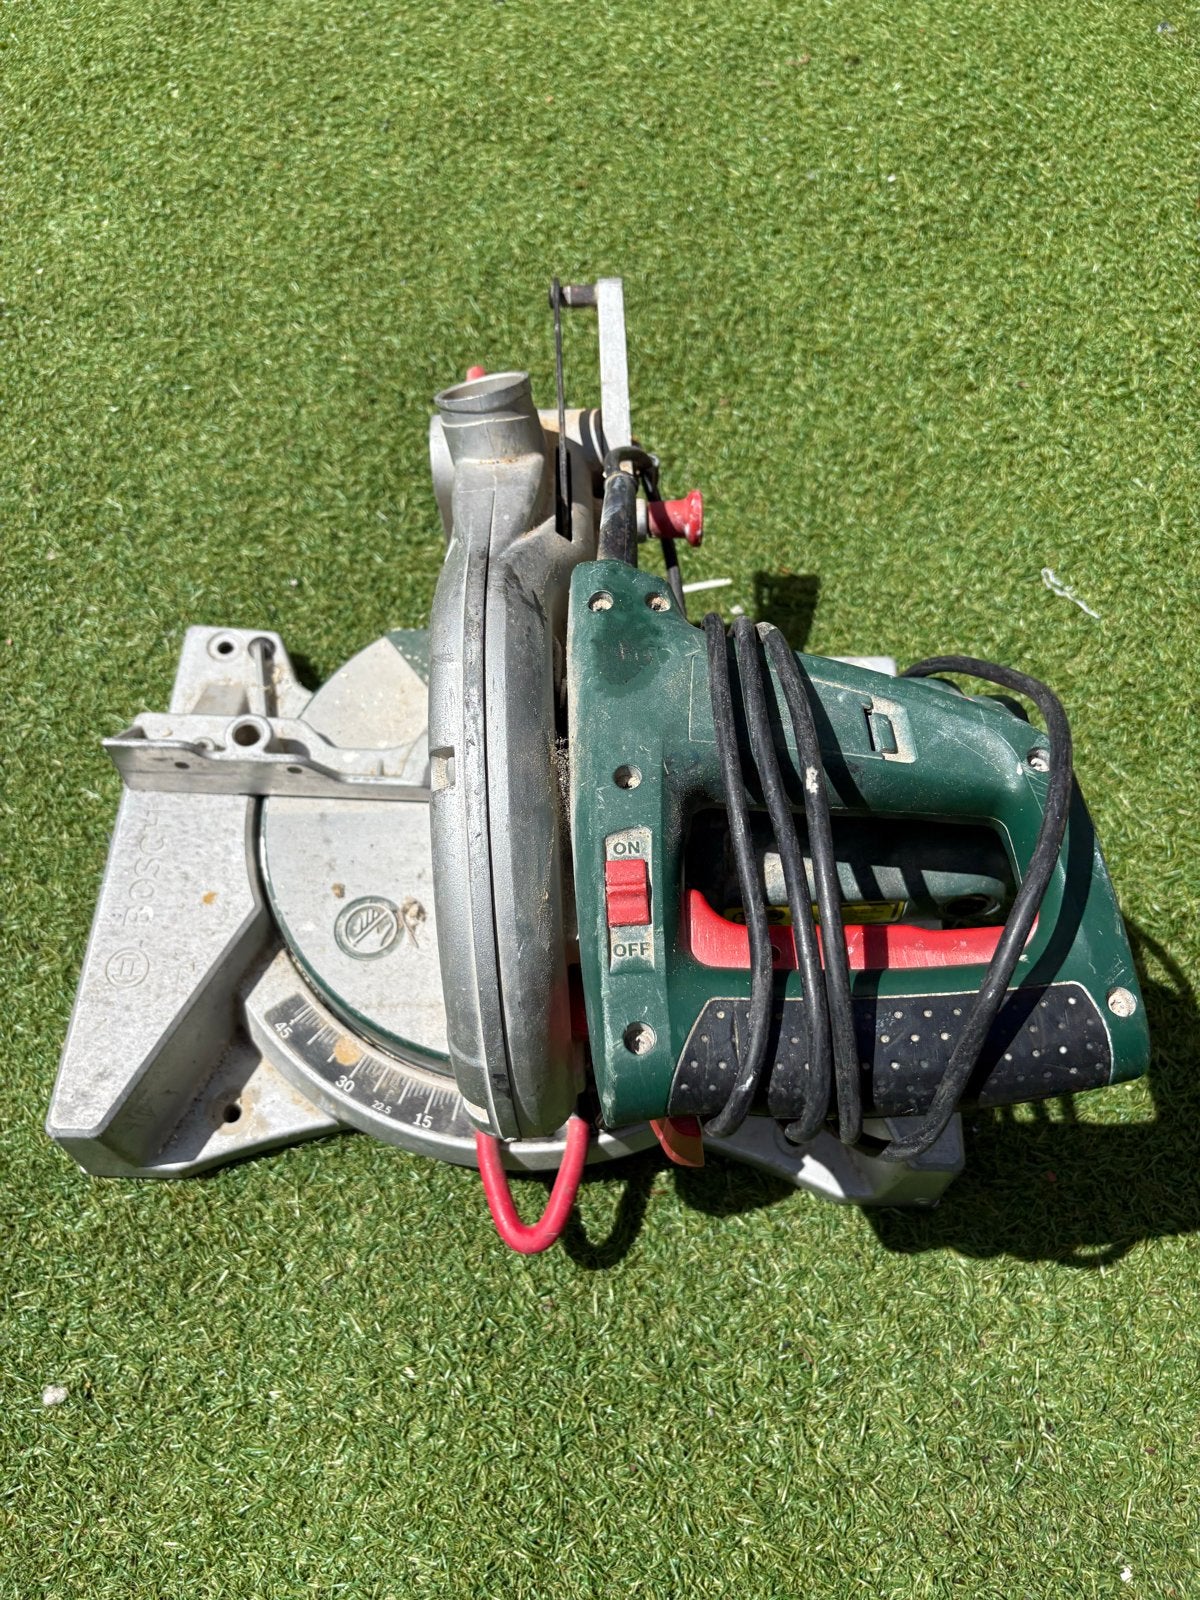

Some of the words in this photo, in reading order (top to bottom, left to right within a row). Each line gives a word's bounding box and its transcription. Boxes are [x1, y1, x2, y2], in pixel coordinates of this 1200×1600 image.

[613, 841, 640, 855] ON
[613, 943, 649, 957] OFF
[274, 1021, 292, 1038] 45
[335, 1075, 355, 1093] 30
[371, 1099, 392, 1115] 22.5
[413, 1112, 433, 1129] 15
